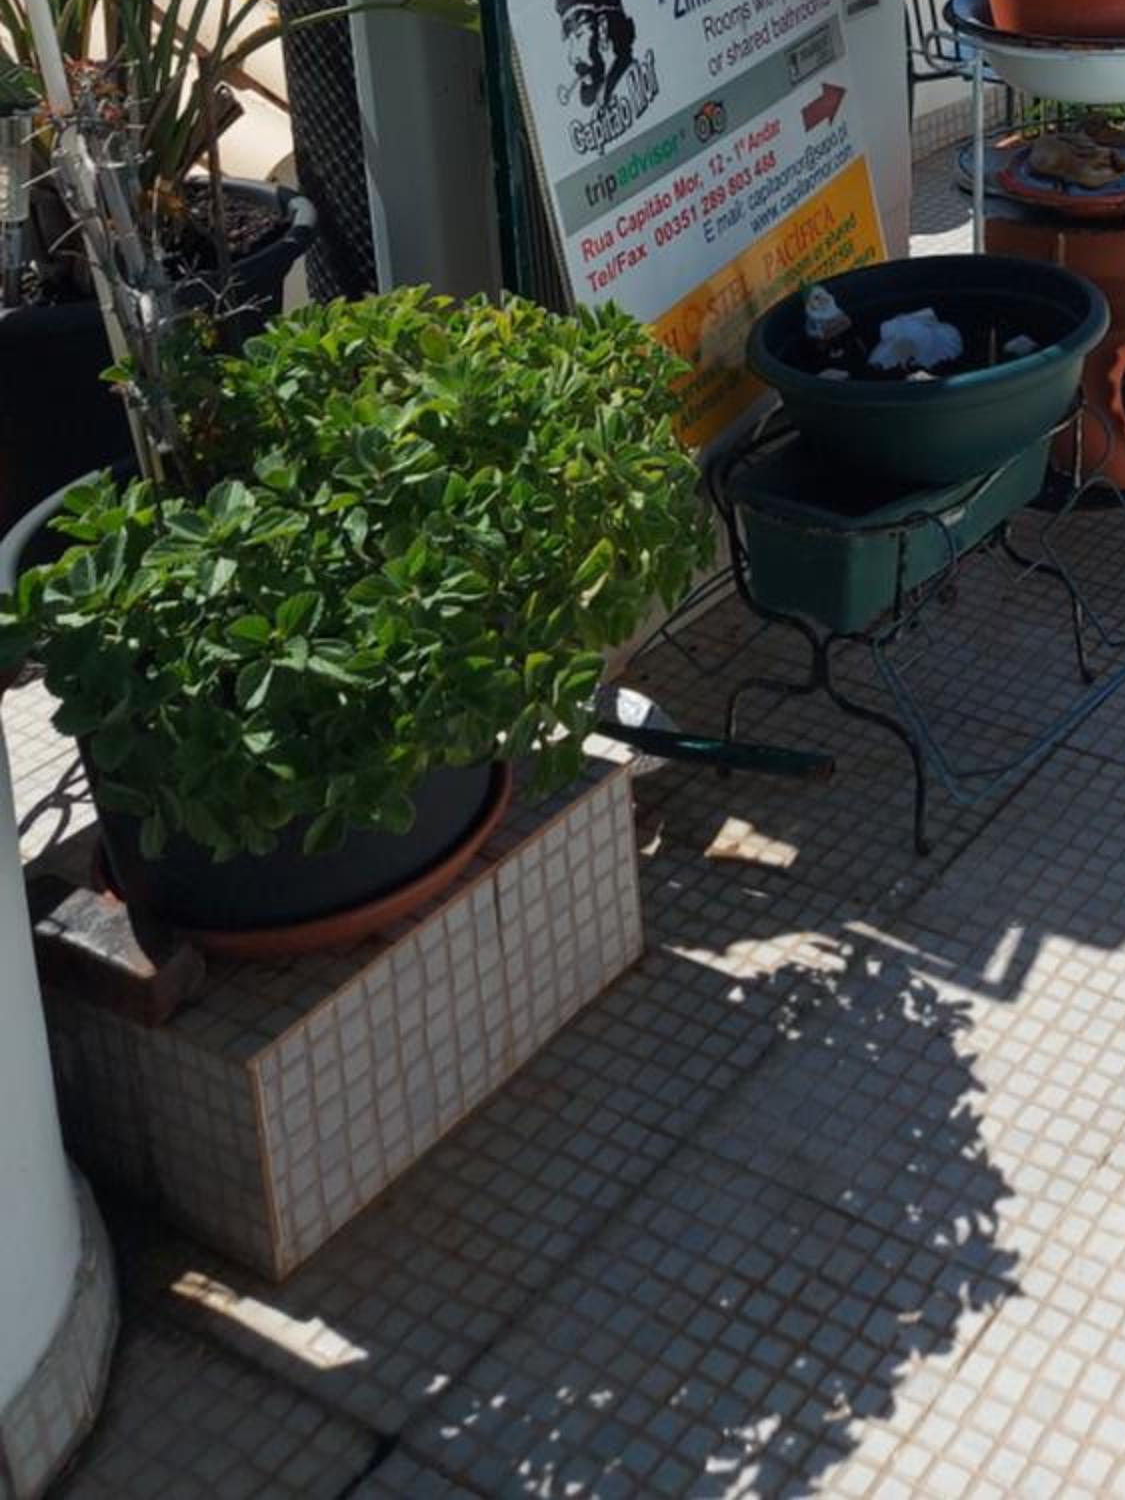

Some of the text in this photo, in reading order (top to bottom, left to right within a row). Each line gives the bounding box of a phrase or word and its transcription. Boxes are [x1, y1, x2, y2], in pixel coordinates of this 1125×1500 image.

[702, 1, 752, 42] Rooms
[707, 53, 725, 77] or
[725, 24, 771, 67] shared
[581, 229, 615, 263] Rua
[616, 191, 673, 239] Capitão
[709, 153, 725, 177] 12
[587, 243, 648, 291] Tel/Fax
[654, 204, 698, 248] 00351
[702, 185, 727, 216] 289
